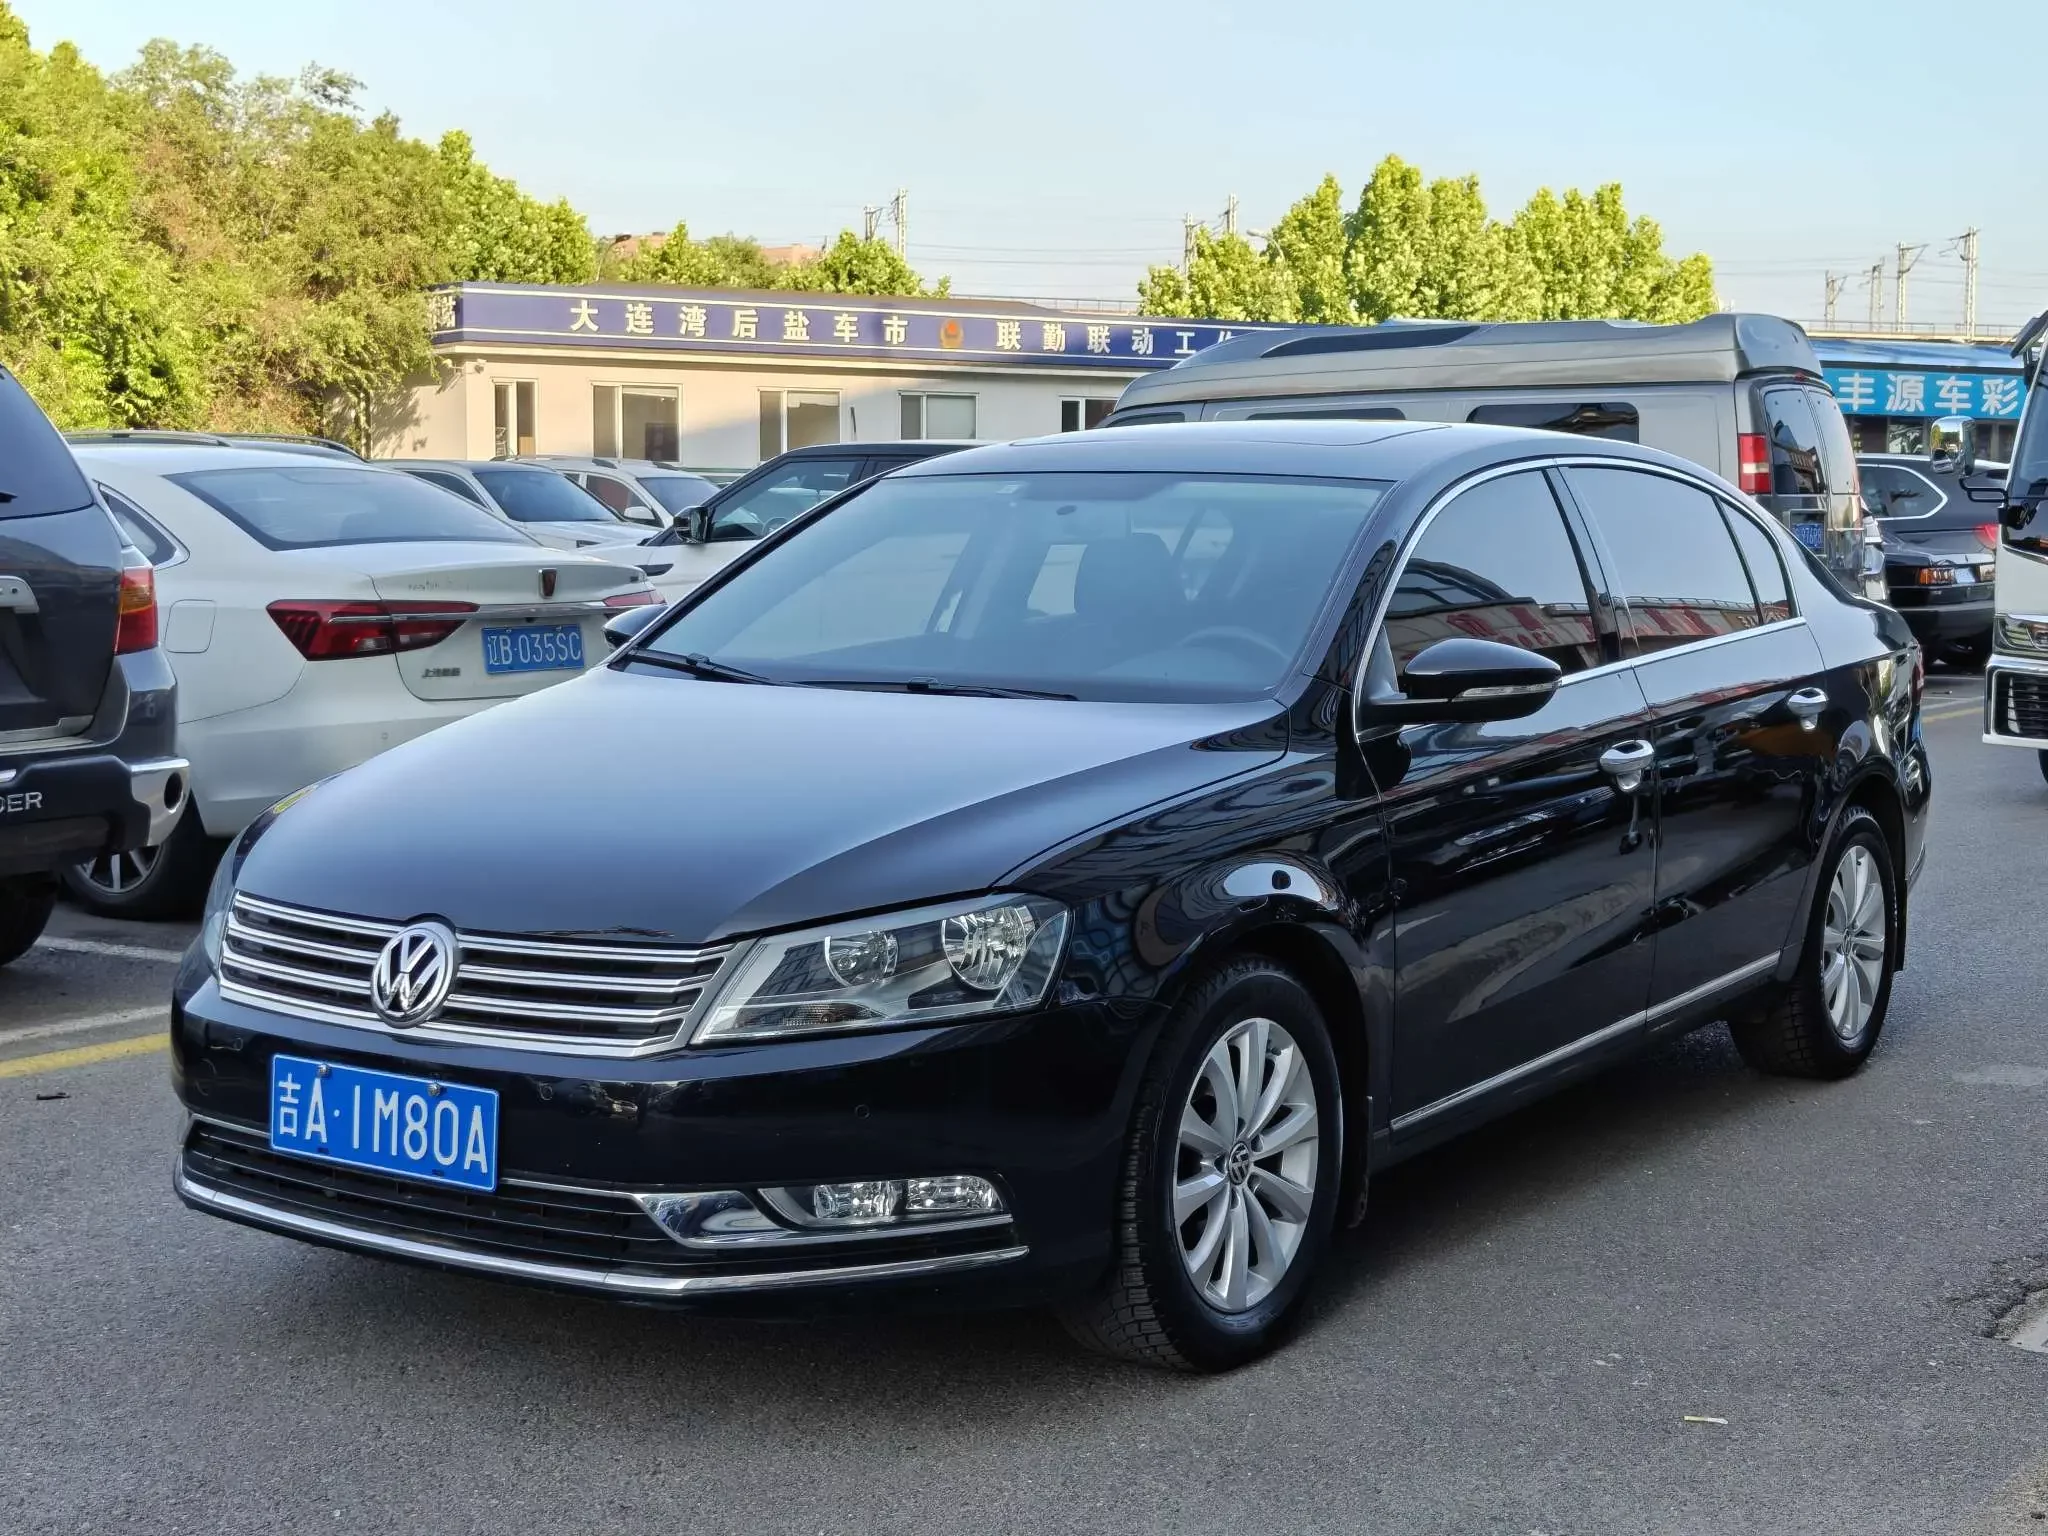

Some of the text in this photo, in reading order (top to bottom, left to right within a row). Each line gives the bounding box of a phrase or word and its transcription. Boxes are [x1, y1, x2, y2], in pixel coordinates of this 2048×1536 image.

[571, 299, 908, 345] 大连湾后盐车市
[1838, 373, 2019, 415] 丰源车彩
